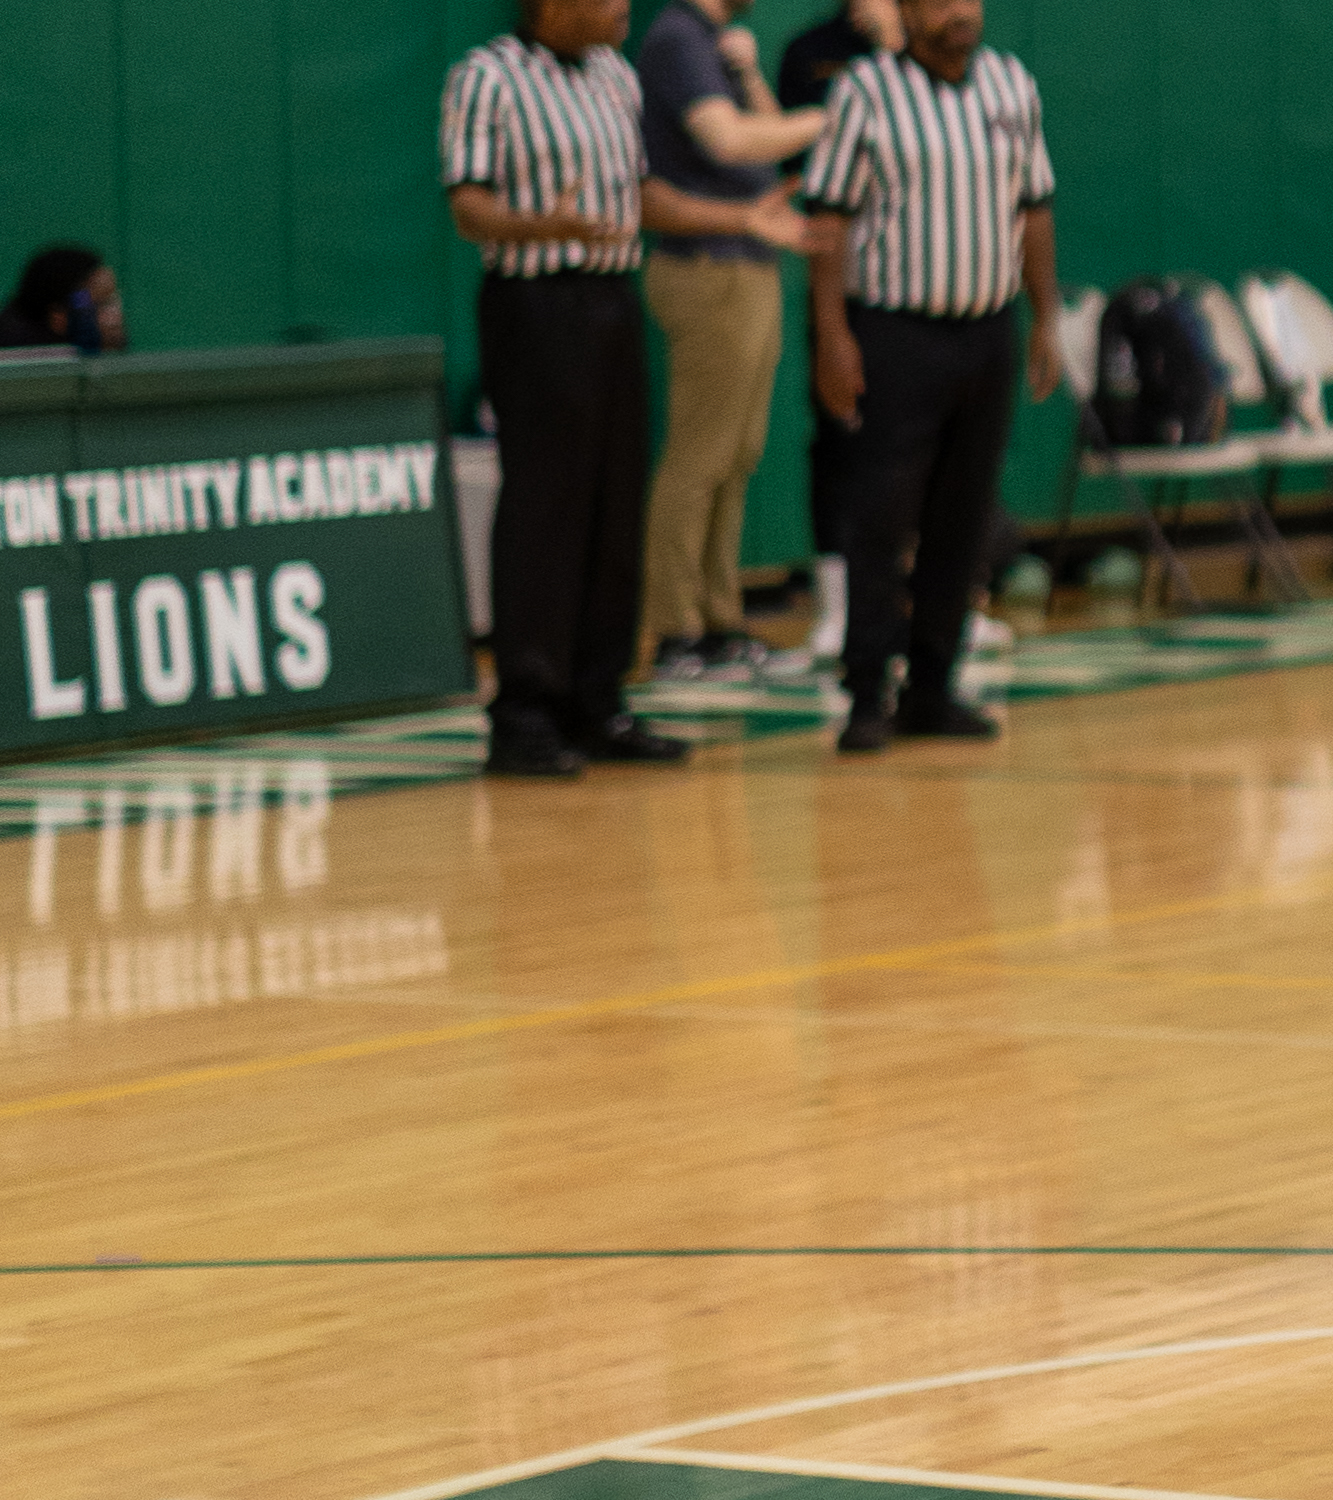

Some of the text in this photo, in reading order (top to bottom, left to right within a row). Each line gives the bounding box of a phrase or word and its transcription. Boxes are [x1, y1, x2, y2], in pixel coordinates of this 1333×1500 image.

[0, 442, 437, 548] ON TRINITY ACADEMY
[21, 562, 330, 719] LIONS
